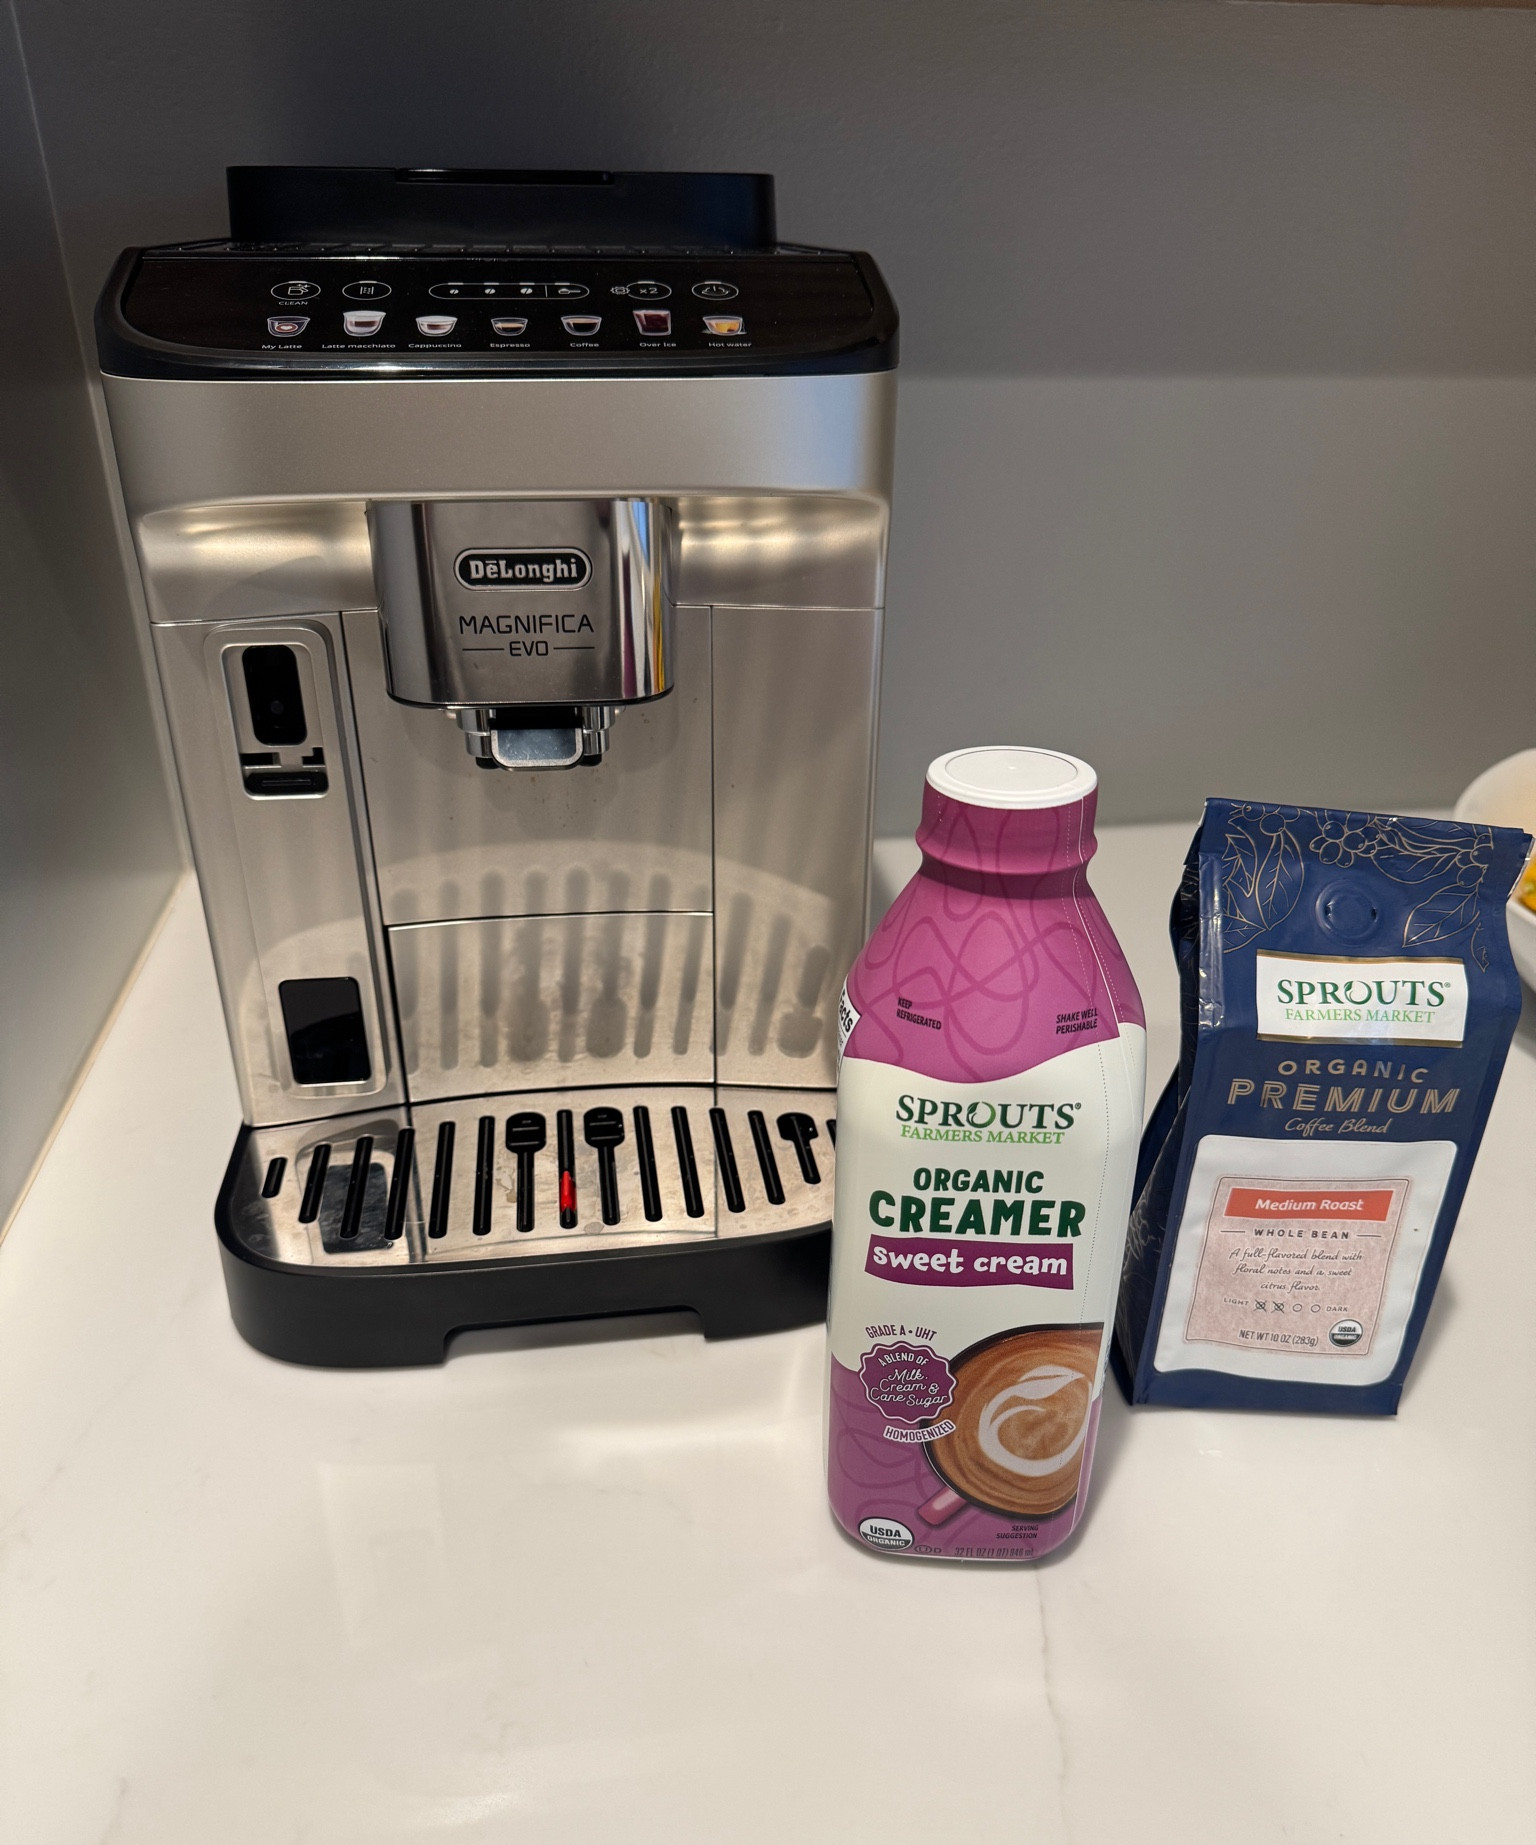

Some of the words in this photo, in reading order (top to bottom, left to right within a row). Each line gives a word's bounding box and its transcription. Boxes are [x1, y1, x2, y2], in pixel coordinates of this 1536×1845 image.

[459, 614, 595, 635] MAGNIFICA
[509, 640, 549, 657] EVO
[897, 996, 913, 1010] KEEP
[896, 1008, 942, 1030] REFRIGERATED
[1056, 1011, 1081, 1024] SHAKE
[1081, 1007, 1098, 1020] WELL
[1284, 1007, 1362, 1022] FARMERS
[1366, 1009, 1436, 1024] MARKET
[1056, 1018, 1098, 1035] PERISHABLE
[1277, 1058, 1429, 1084] ORGANIC
[1227, 1078, 1461, 1115] PREMIUM
[900, 1124, 983, 1143] FARMERS
[986, 1129, 1066, 1145] MARKET
[1284, 1117, 1334, 1137] Coffee
[1337, 1117, 1393, 1134] Blend
[913, 1167, 1045, 1194] ORGANIC
[1255, 1198, 1316, 1211] Medium
[1319, 1199, 1364, 1211] Roast
[868, 1190, 1086, 1238] CREAMER
[1254, 1228, 1304, 1238] WHOLE
[1311, 1230, 1350, 1240] BEAN
[872, 1245, 965, 1274] sweet
[972, 1254, 1068, 1275] cream
[1229, 1248, 1241, 1260] A
[1240, 1248, 1309, 1262] full-flavored
[1311, 1249, 1340, 1260] blend
[1342, 1250, 1363, 1260] with
[1231, 1263, 1266, 1275] floral
[1267, 1266, 1291, 1275] notes
[1294, 1265, 1315, 1275] and
[1327, 1268, 1353, 1276] sweet
[1260, 1281, 1286, 1290] citrus
[1223, 1297, 1249, 1306] LIGHT
[865, 1324, 898, 1339] GRADE
[899, 1325, 907, 1336] A
[915, 1326, 937, 1341] UHT
[1238, 1329, 1256, 1340] NET
[1256, 1331, 1270, 1341] WT
[1270, 1333, 1279, 1342] 10
[1280, 1333, 1292, 1344] OZ
[1292, 1336, 1319, 1348] (283g)
[878, 1357, 886, 1367] A
[884, 1352, 915, 1364] BLEND
[916, 1354, 929, 1366] OF
[879, 1378, 927, 1392] Cream
[870, 1387, 906, 1401] Cane
[906, 1394, 948, 1408] Sugar
[885, 1420, 955, 1442] HOMOGENIZED
[869, 1524, 902, 1538] USDA
[1010, 1524, 1039, 1532] SERVING
[866, 1535, 905, 1546] ORGANIC
[954, 1547, 965, 1556] 32
